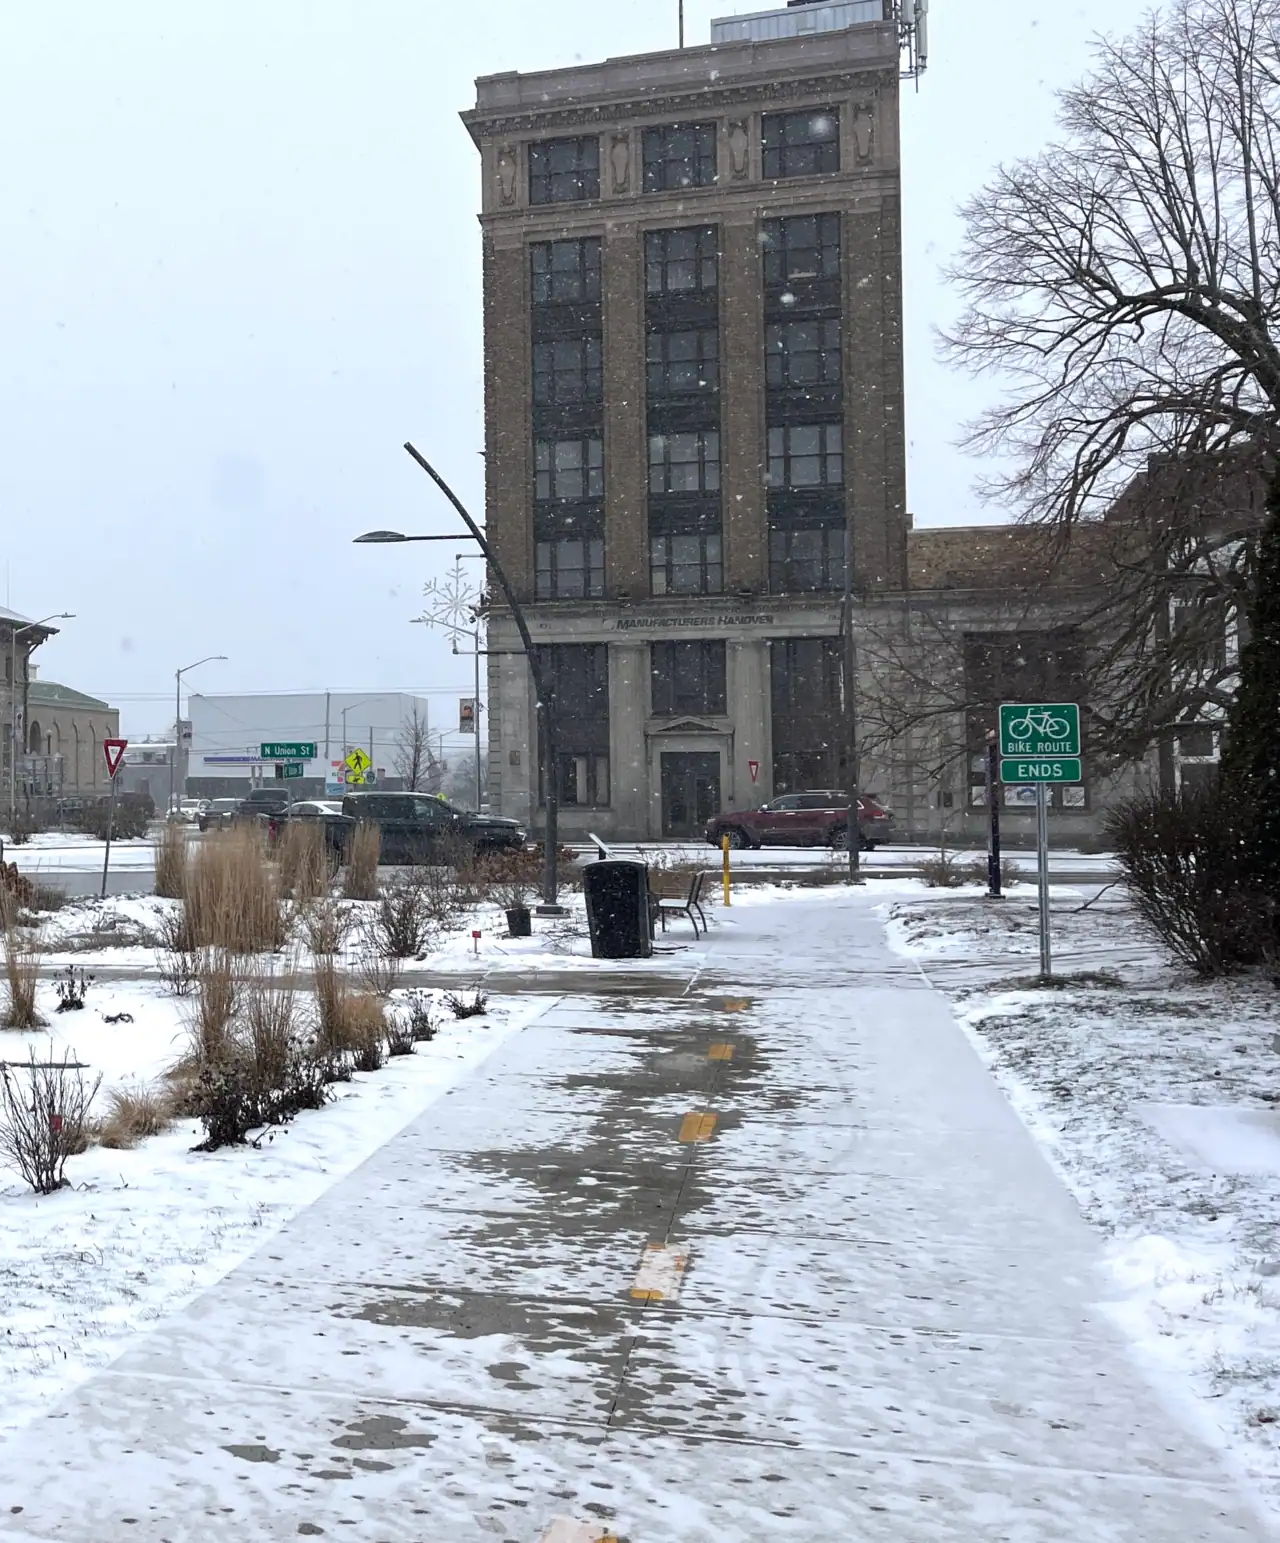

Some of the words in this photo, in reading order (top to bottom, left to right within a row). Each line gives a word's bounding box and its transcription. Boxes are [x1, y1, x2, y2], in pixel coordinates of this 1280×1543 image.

[617, 616, 715, 630] MANUFACTURERS
[718, 615, 773, 625] HANOVER
[264, 746, 271, 755] N
[274, 746, 297, 755] Union
[300, 745, 310, 755] St
[1008, 741, 1032, 753] BIKE
[1037, 742, 1072, 752] ROUTE
[1018, 764, 1063, 777] ENDS
